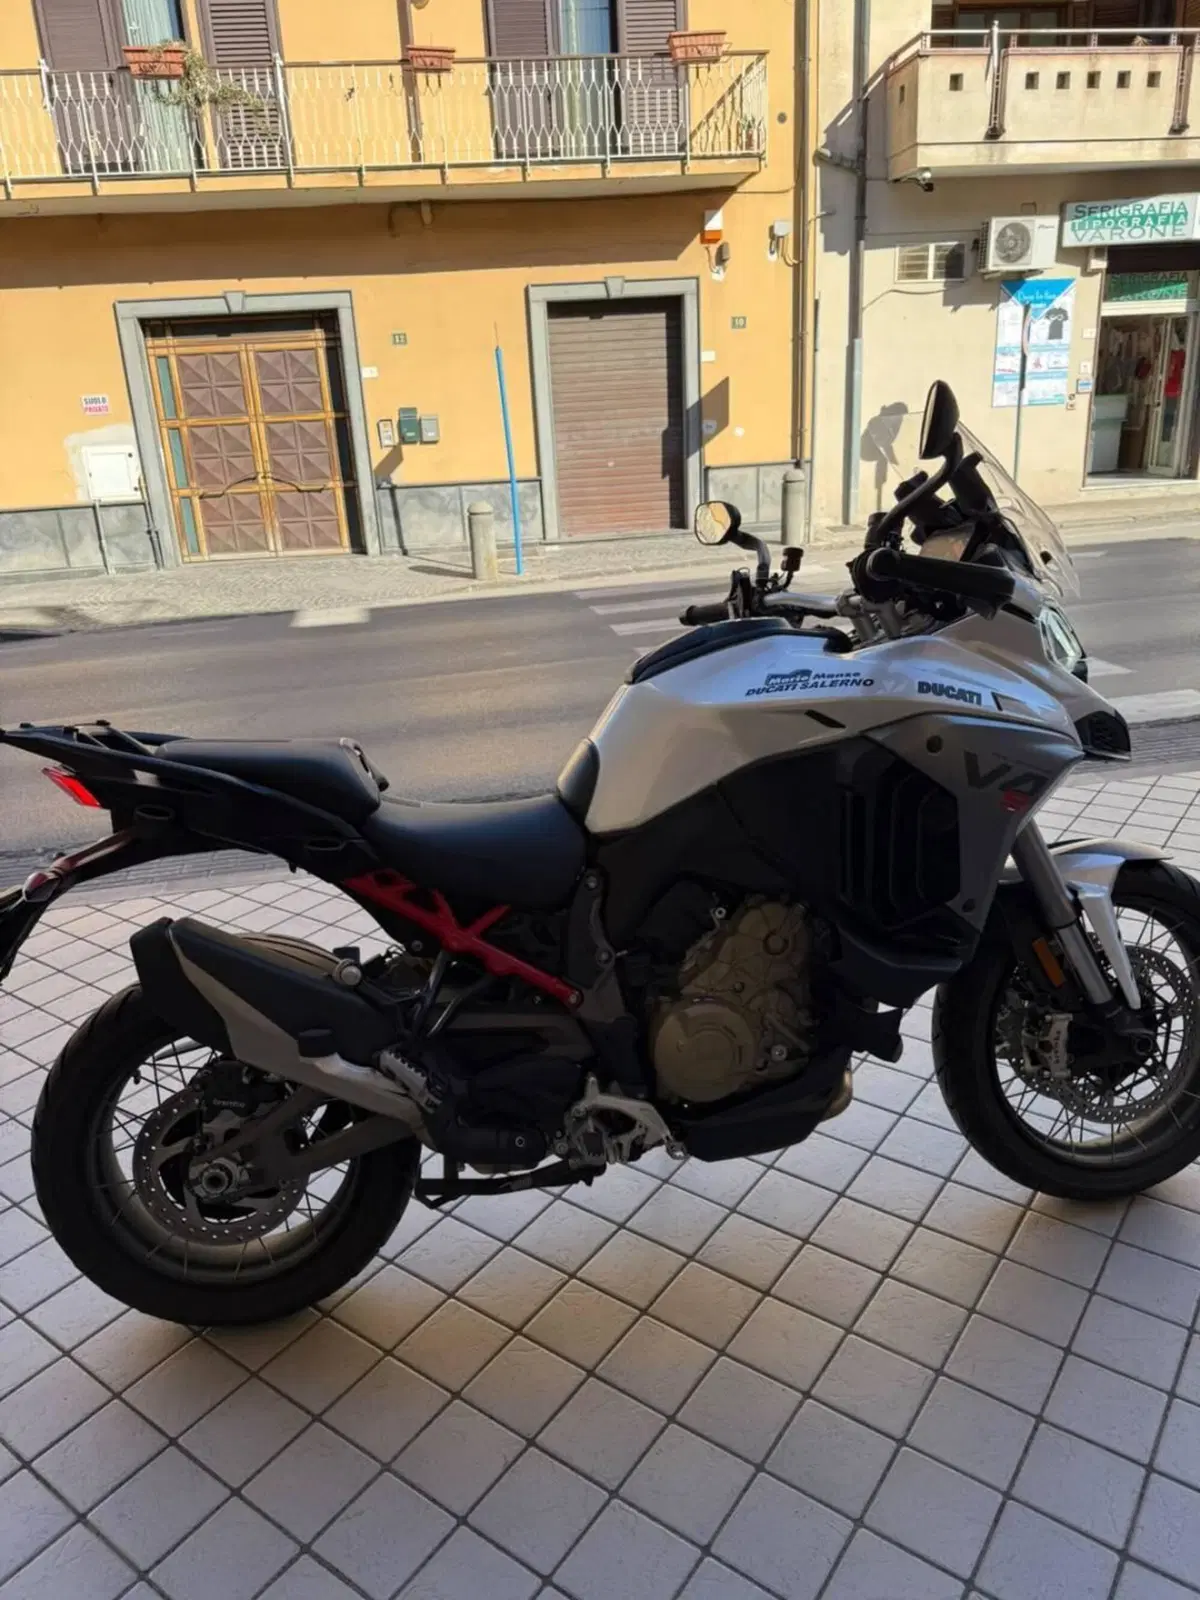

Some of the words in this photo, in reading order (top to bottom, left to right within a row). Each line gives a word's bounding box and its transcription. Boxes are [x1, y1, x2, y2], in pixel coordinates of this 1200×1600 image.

[1073, 201, 1188, 219] SERIGRAFIA
[1074, 215, 1186, 231] TIPOGRAFIA
[1072, 226, 1185, 242] VARONE
[745, 682, 798, 697] DUCATI
[799, 678, 874, 690] SALERNO
[917, 681, 982, 706] DUCATI
